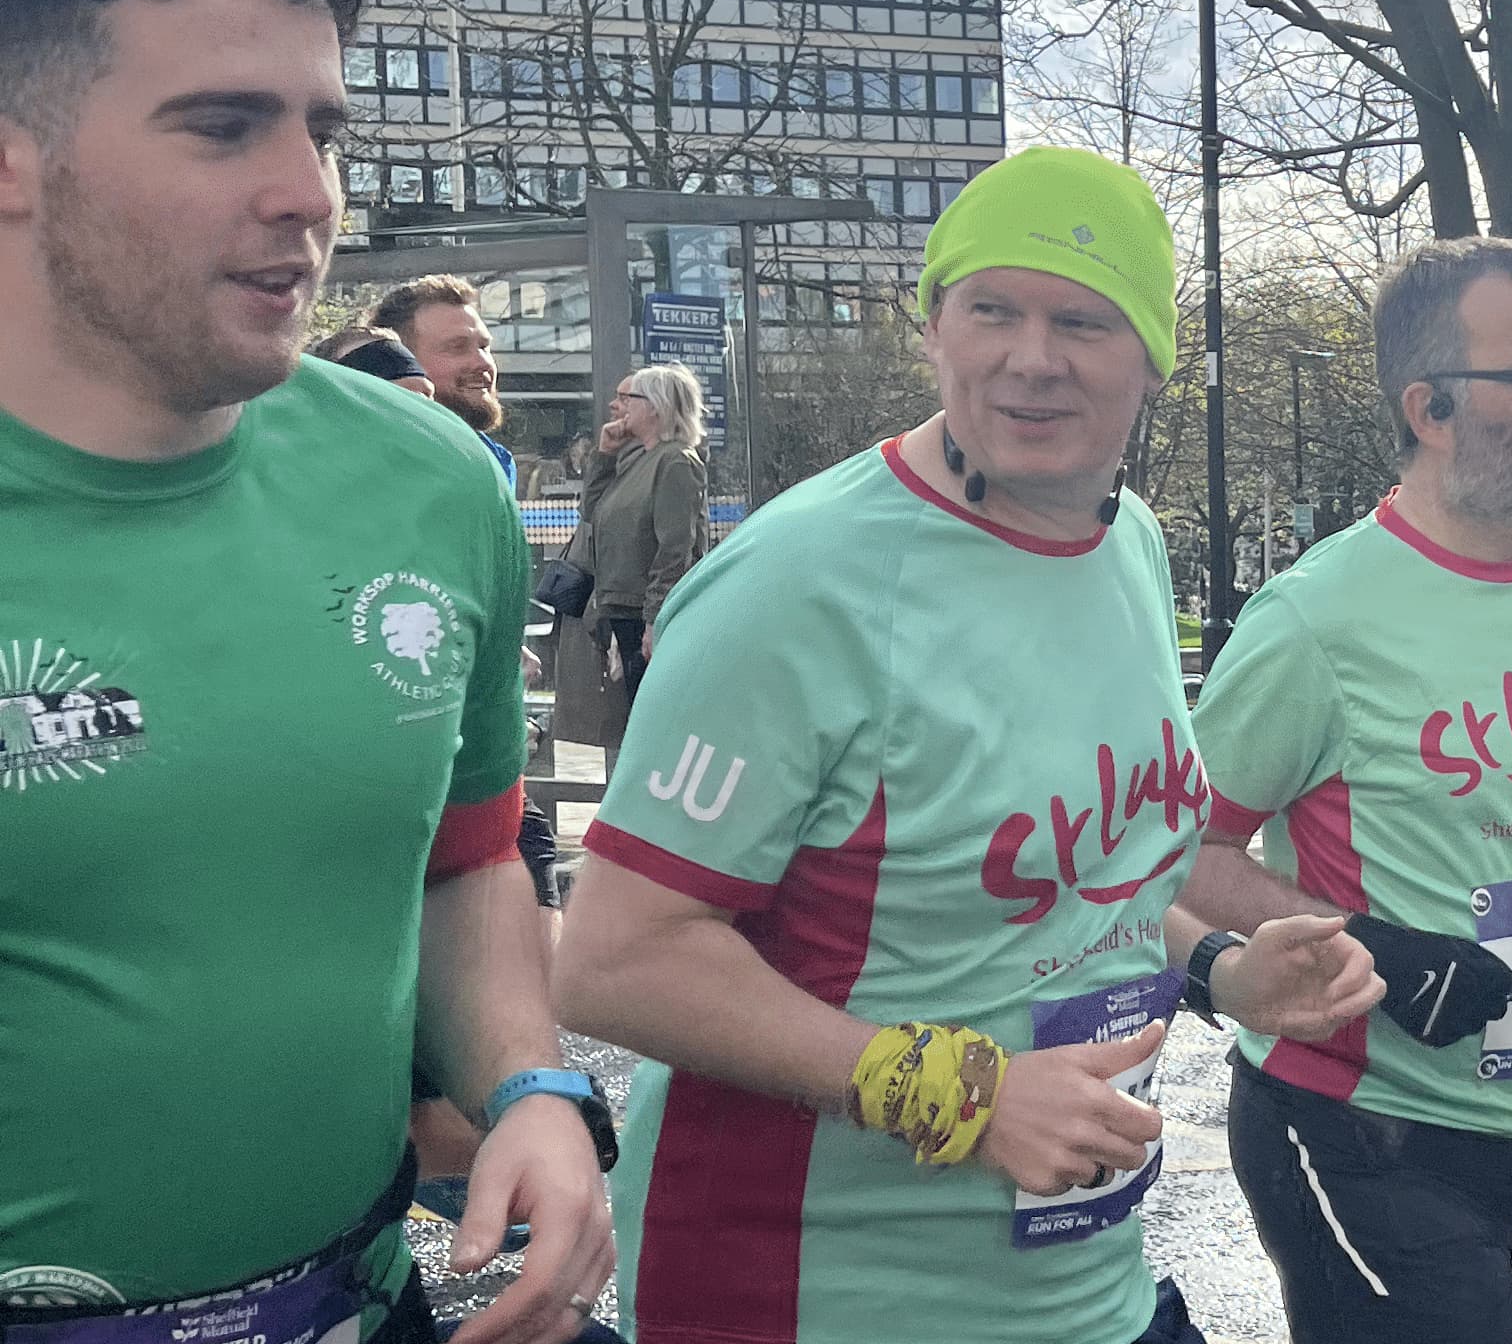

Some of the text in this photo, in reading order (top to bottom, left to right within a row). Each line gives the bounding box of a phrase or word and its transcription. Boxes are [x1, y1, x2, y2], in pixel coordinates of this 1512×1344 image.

[653, 309, 718, 326] TEKKERS
[352, 572, 394, 645] WORKSOP
[649, 734, 745, 822] JU
[1420, 701, 1502, 796] St
[981, 795, 1093, 924] St
